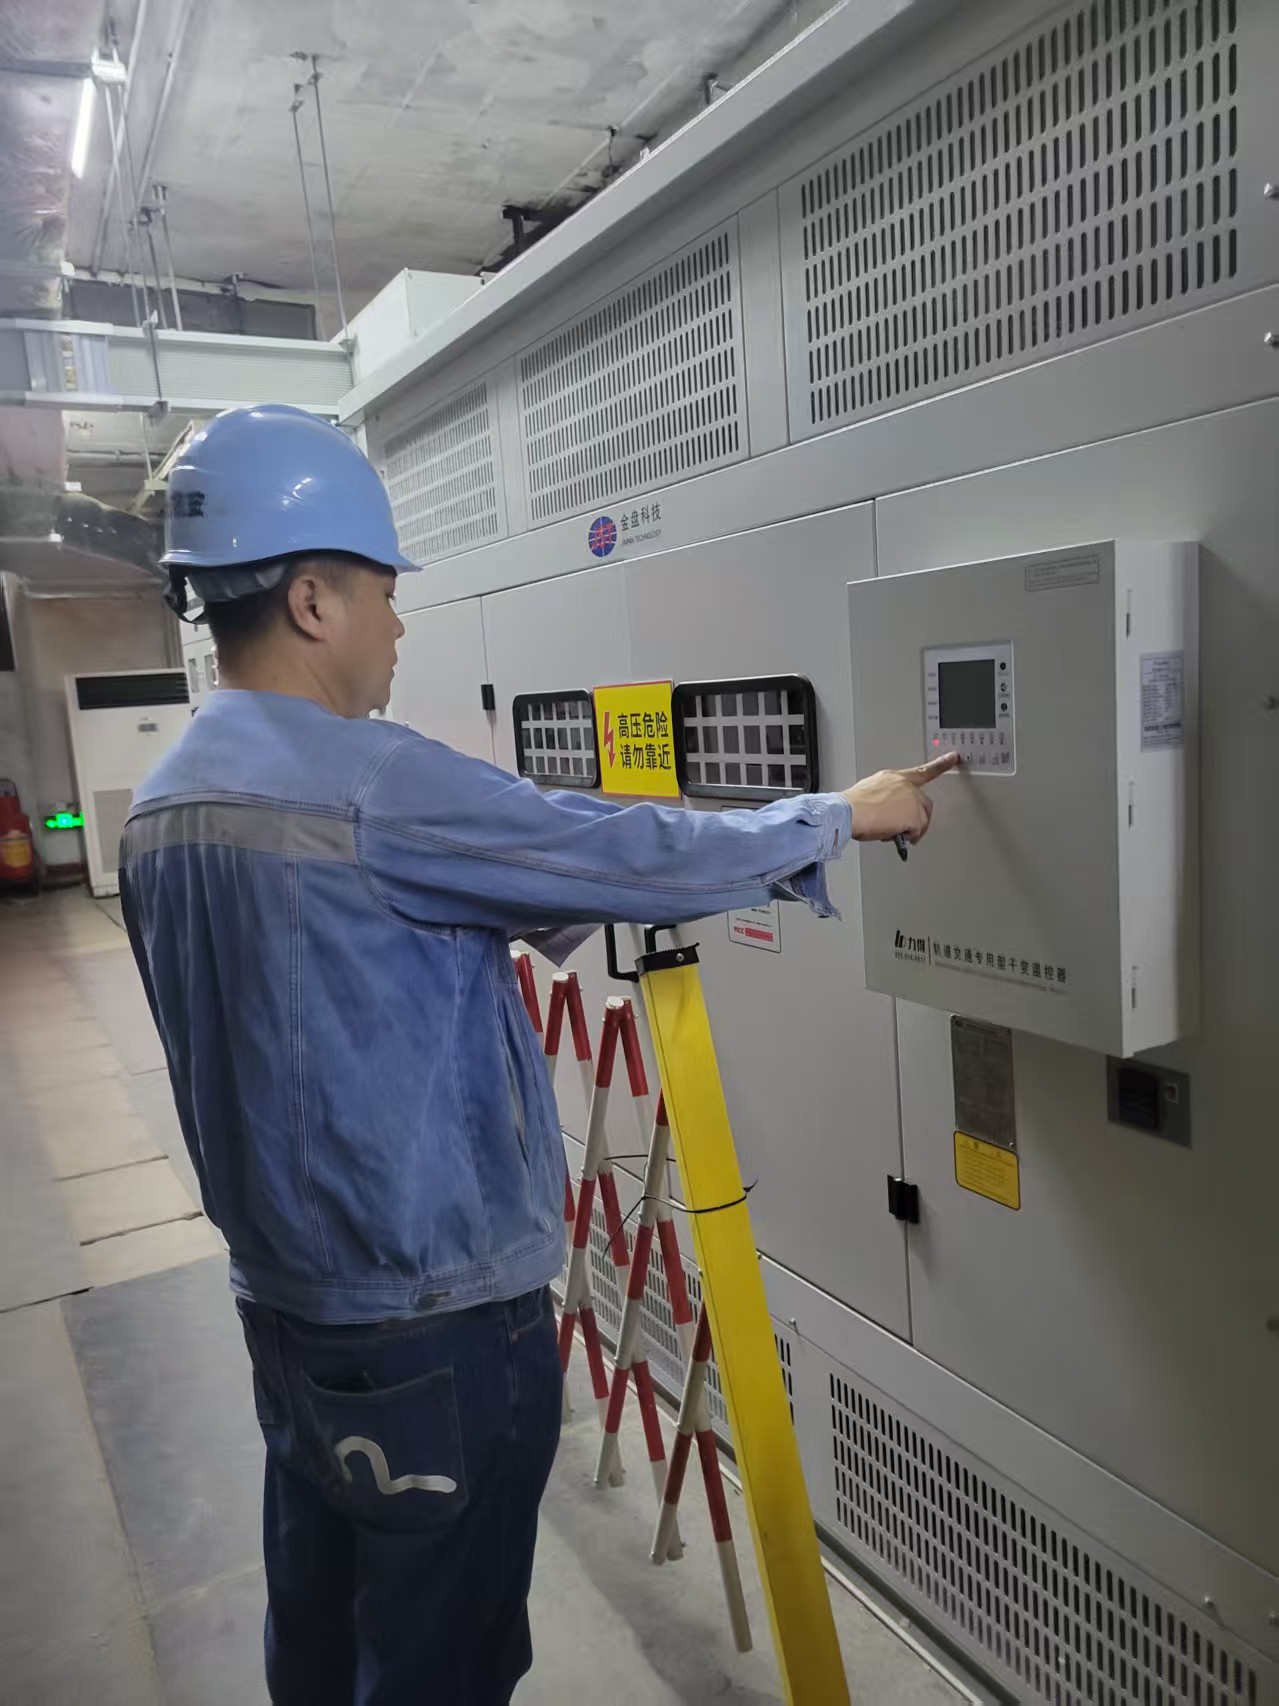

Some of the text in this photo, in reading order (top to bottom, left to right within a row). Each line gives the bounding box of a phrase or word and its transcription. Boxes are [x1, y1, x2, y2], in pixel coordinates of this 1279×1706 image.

[620, 502, 662, 532] 金盘科技
[617, 711, 669, 739] 高压危险
[620, 743, 671, 770] 请勿靠近
